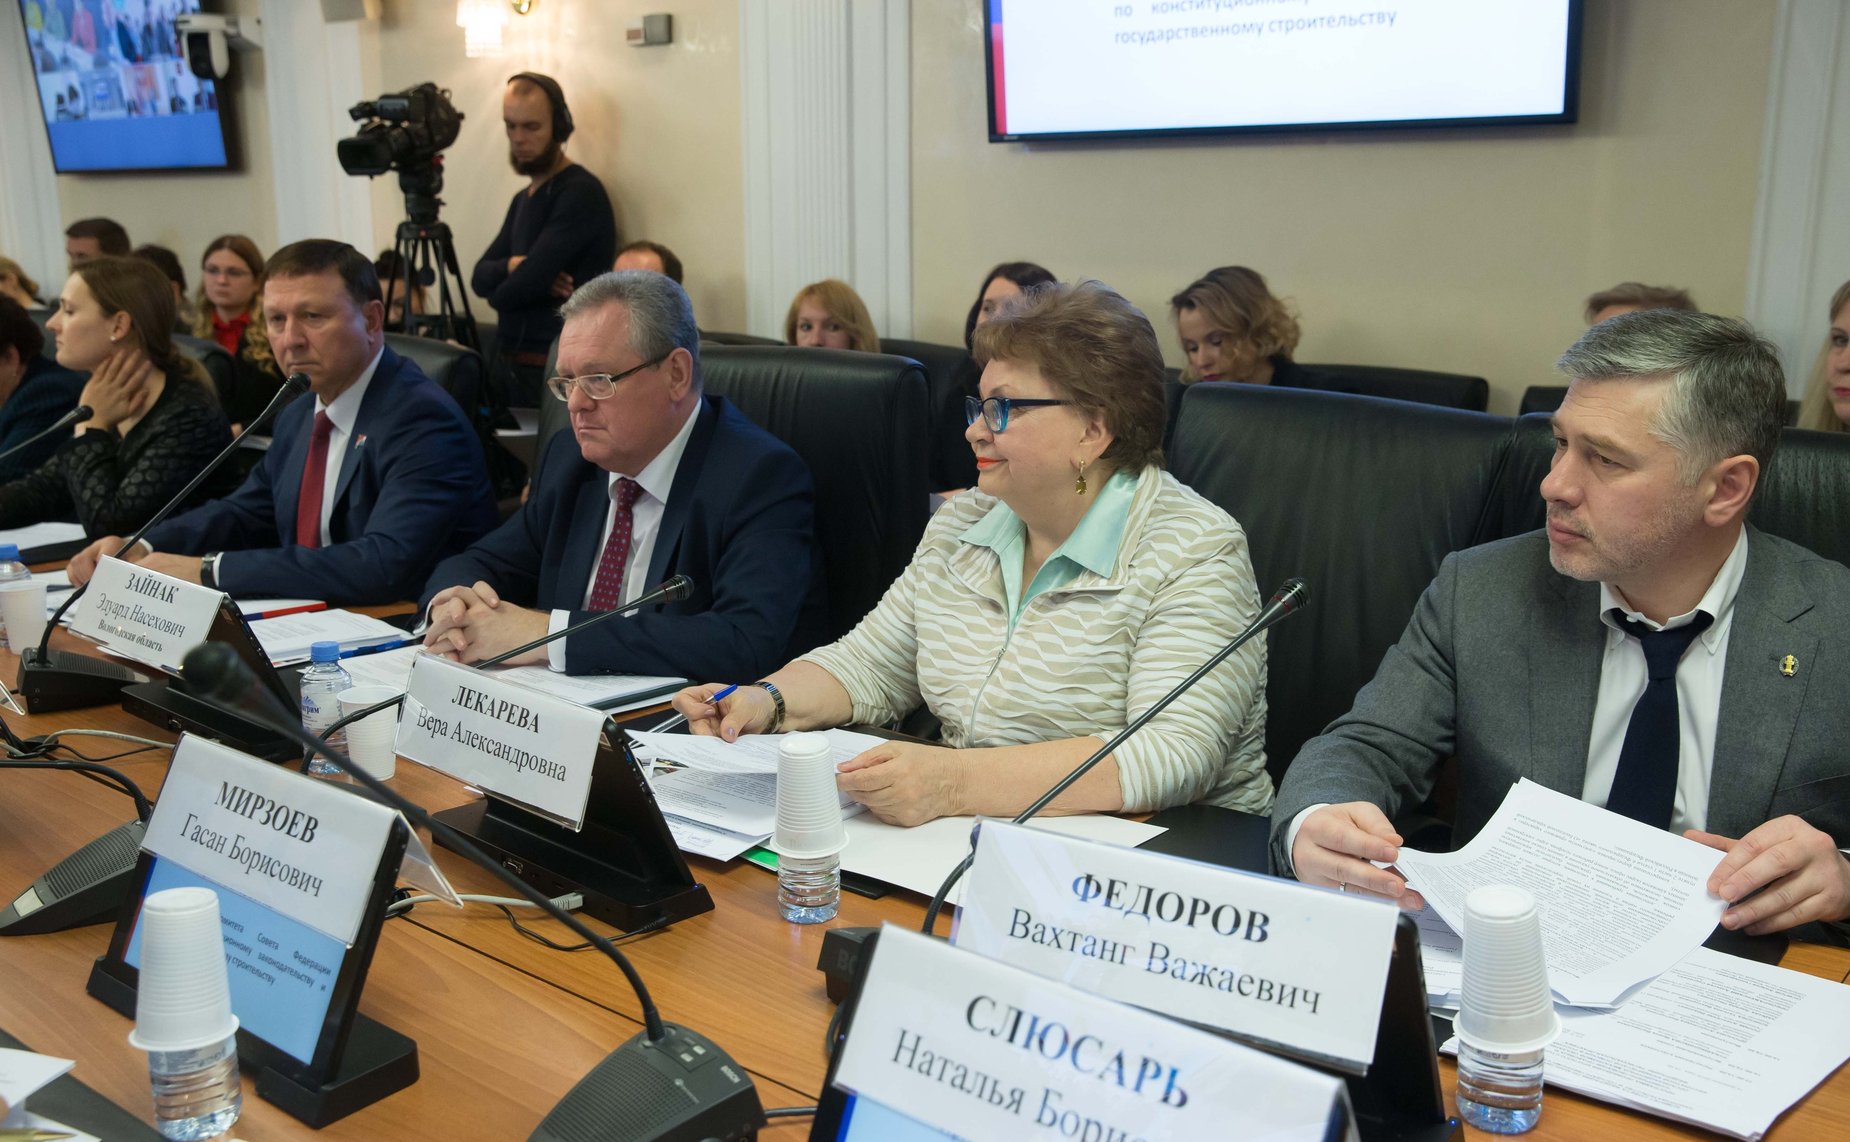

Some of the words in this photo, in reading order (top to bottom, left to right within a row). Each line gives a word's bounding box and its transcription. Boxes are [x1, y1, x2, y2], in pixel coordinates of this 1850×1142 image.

[1114, 5, 1133, 18] по
[1114, 21, 1264, 45] государственному
[1268, 10, 1398, 34] строительству
[125, 573, 180, 603] ЗАЙНАК
[96, 593, 130, 619] Эдуард
[130, 604, 186, 638] Насехович
[136, 634, 163, 652] область
[451, 685, 540, 733] ЛЕКАРЕВА
[416, 706, 447, 738] Вера
[450, 720, 568, 782] Александровна
[214, 781, 319, 843] МИРЗОЕВ
[180, 813, 228, 854] Гасан
[228, 834, 323, 897] Борисович
[1072, 873, 1270, 943] ФЕДОРОВ
[231, 956, 276, 986] строительству
[257, 932, 279, 950] Совета
[293, 950, 332, 976] Федерации
[258, 952, 315, 987] законодательству
[1008, 908, 1136, 965] Вахтанг
[1146, 941, 1323, 1014] Важаевич
[966, 995, 1188, 1108] СЛЮСАРЬ
[893, 1028, 1028, 1116] Наталья
[1036, 1087, 1147, 1142] Бори
